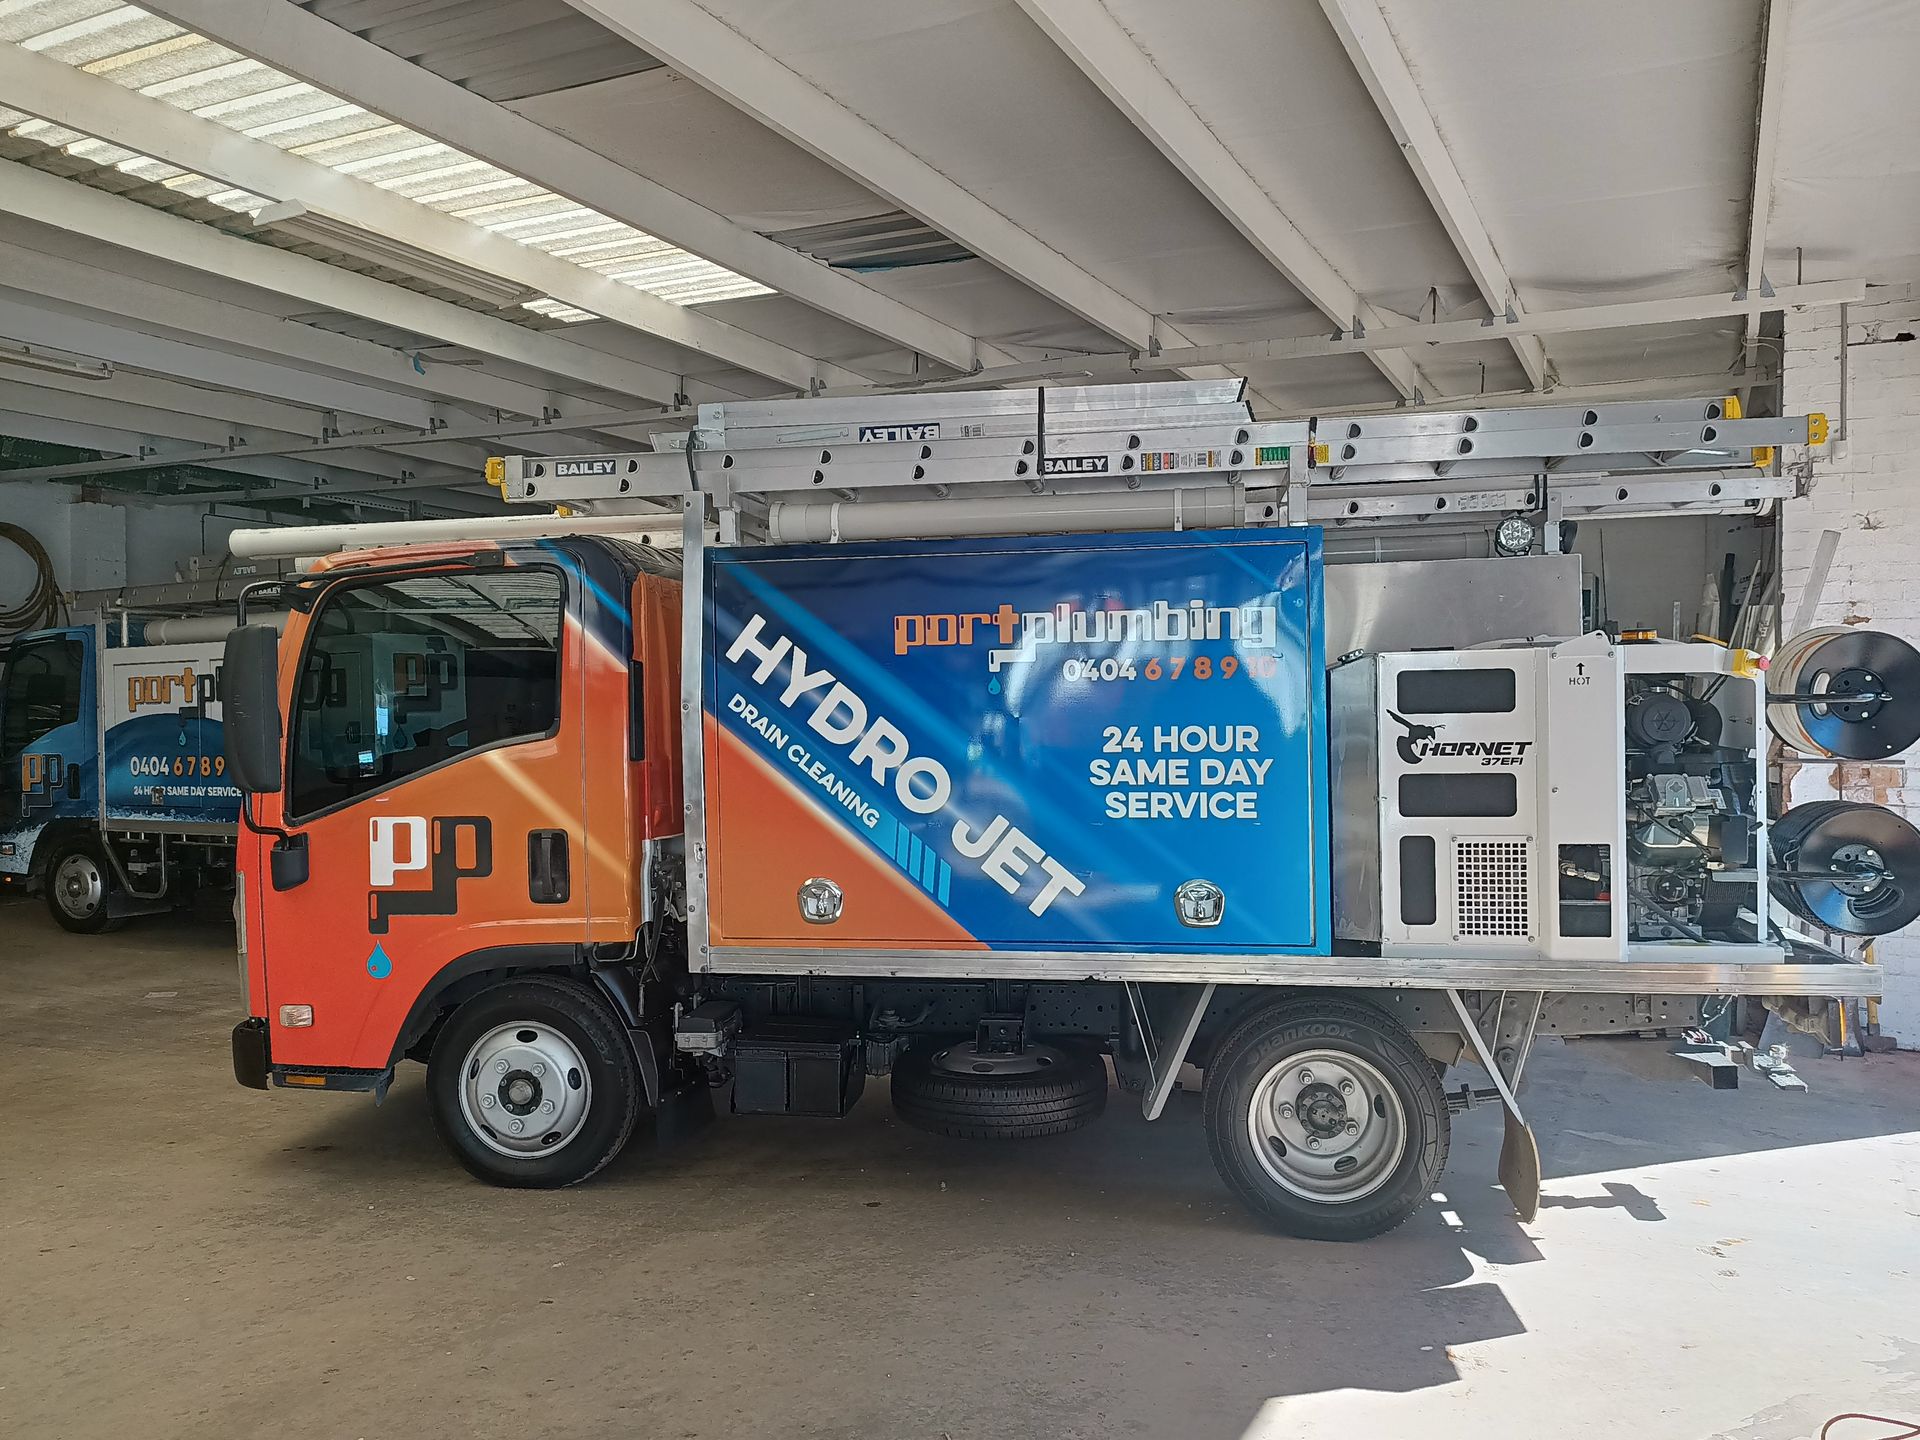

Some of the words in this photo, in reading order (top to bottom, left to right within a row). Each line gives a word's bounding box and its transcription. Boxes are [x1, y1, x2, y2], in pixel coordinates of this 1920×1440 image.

[862, 425, 937, 441] BAILEY
[557, 461, 614, 475] BAILEY
[1044, 459, 1107, 472] BAILEY
[1062, 658, 1137, 682] 0404
[1569, 676, 1591, 686] HOT
[1102, 726, 1143, 753] 24
[1153, 725, 1259, 753] HOUR
[1419, 741, 1532, 757] HORNET
[130, 756, 170, 777] 0404
[725, 613, 951, 814] HYDRO
[952, 814, 1086, 917] JET
[728, 693, 789, 750] DRAIN
[787, 744, 880, 829] CLEANING
[1480, 757, 1523, 766] 37EFI
[1089, 758, 1190, 786] SAME
[1200, 758, 1274, 785] DAY
[133, 786, 142, 796] 24
[168, 786, 189, 796] SAME
[190, 786, 206, 796] DAY
[207, 786, 243, 797] SERVICE
[1105, 791, 1258, 819] SERVICE
